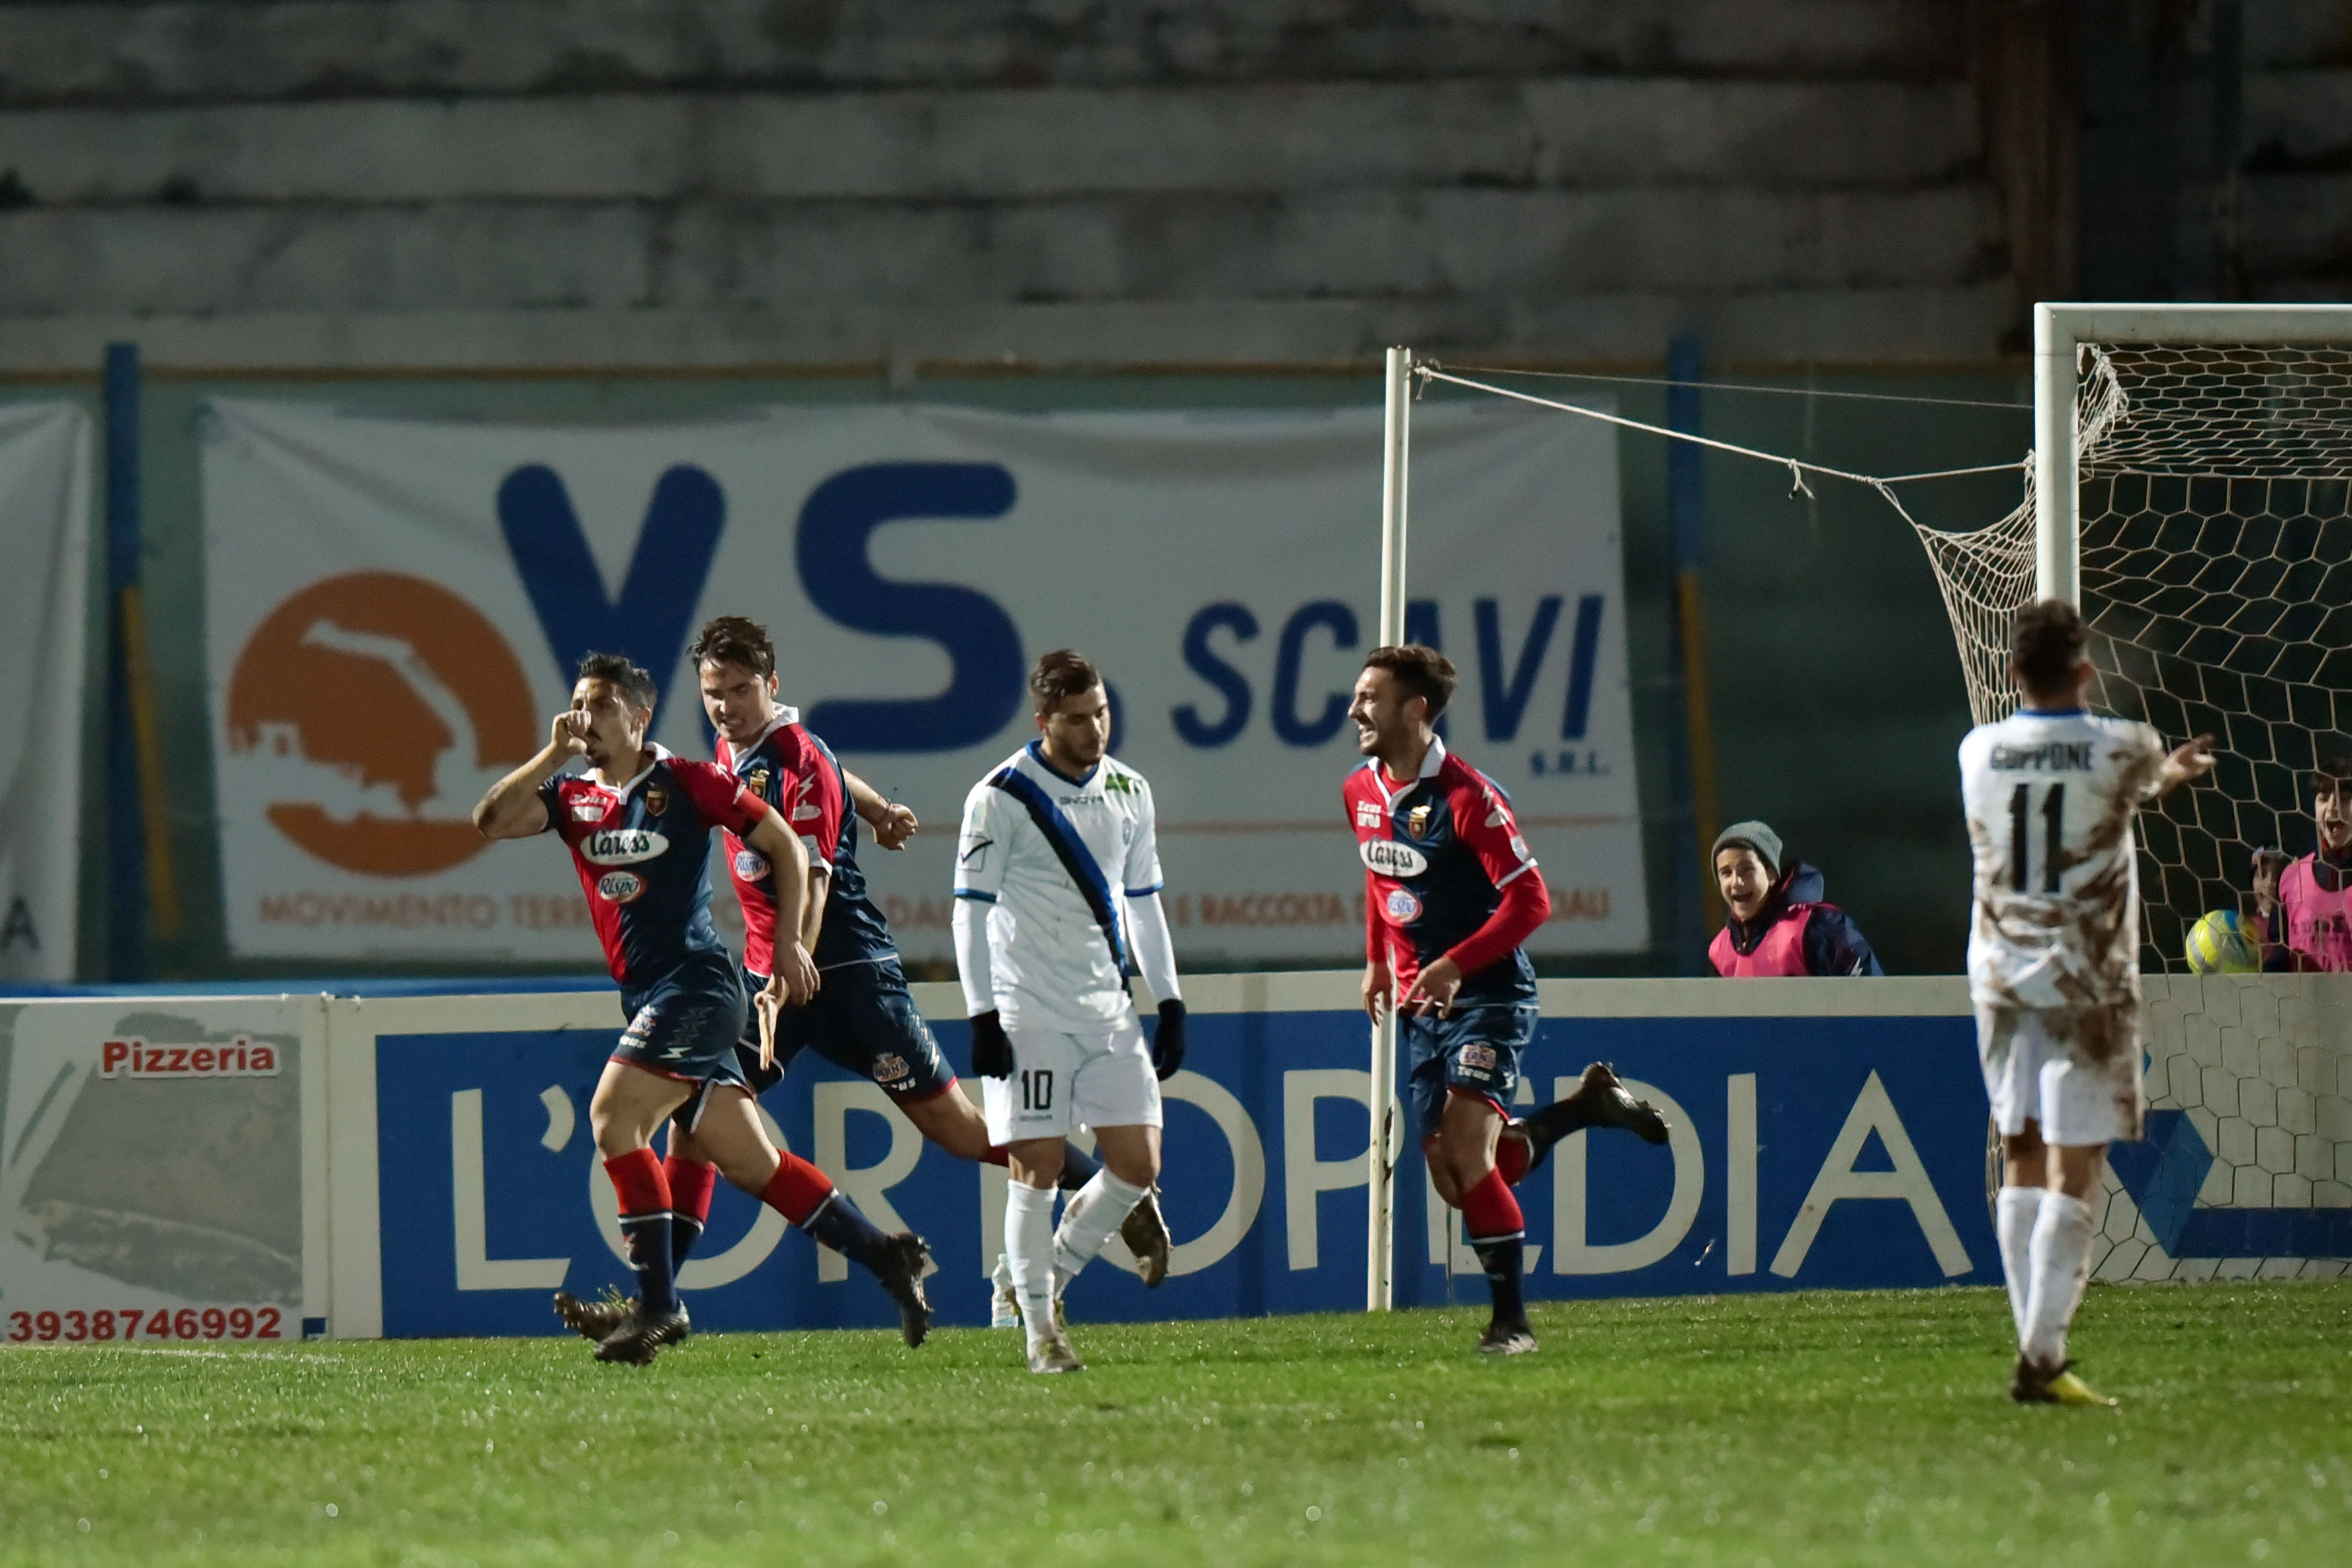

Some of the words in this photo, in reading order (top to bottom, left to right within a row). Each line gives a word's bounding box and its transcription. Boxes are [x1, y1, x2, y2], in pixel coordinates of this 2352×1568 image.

[2009, 783, 2064, 892] 11
[103, 1039, 275, 1072] Pizzeria
[1022, 1069, 1053, 1110] 10
[9, 1307, 281, 1342] 3938746992
